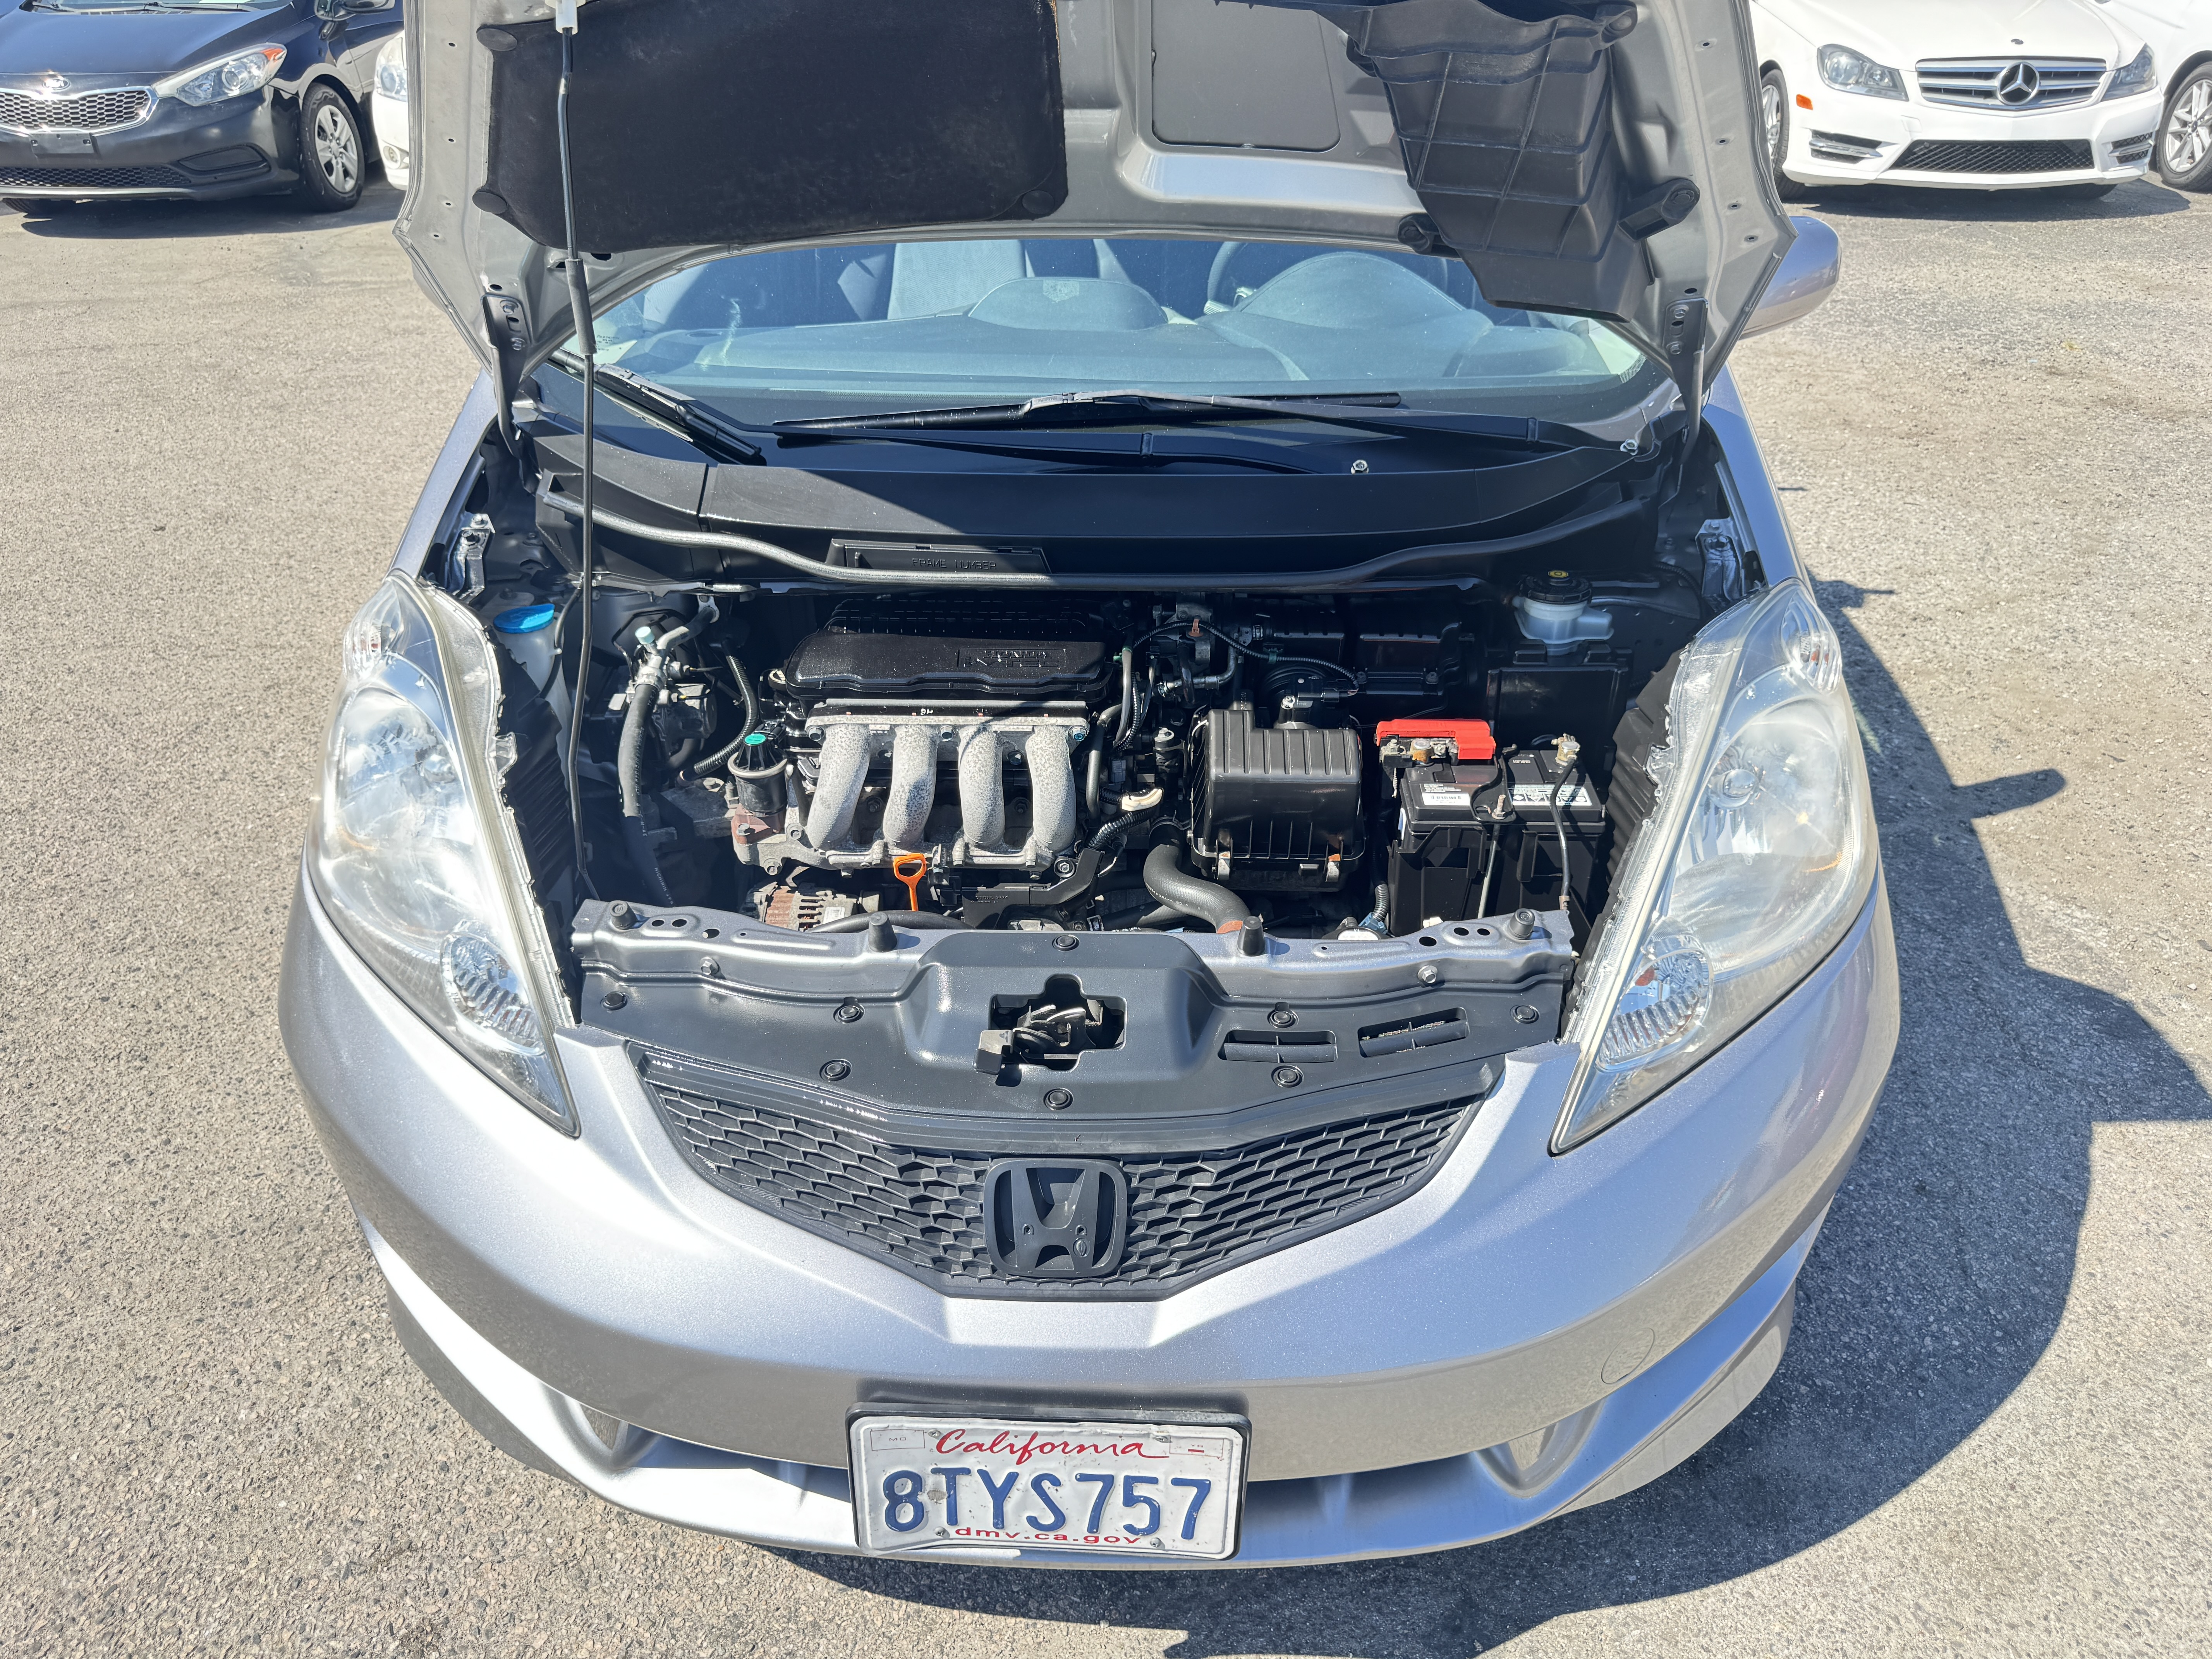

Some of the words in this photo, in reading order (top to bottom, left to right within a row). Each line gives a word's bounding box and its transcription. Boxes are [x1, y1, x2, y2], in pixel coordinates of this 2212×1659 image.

[912, 558, 947, 568] FRAME
[954, 560, 997, 570] NUMBER
[936, 1429, 1170, 1465] California
[883, 1467, 1211, 1540] 8TYS757
[955, 1526, 1142, 1544] dmv.ca.gov
